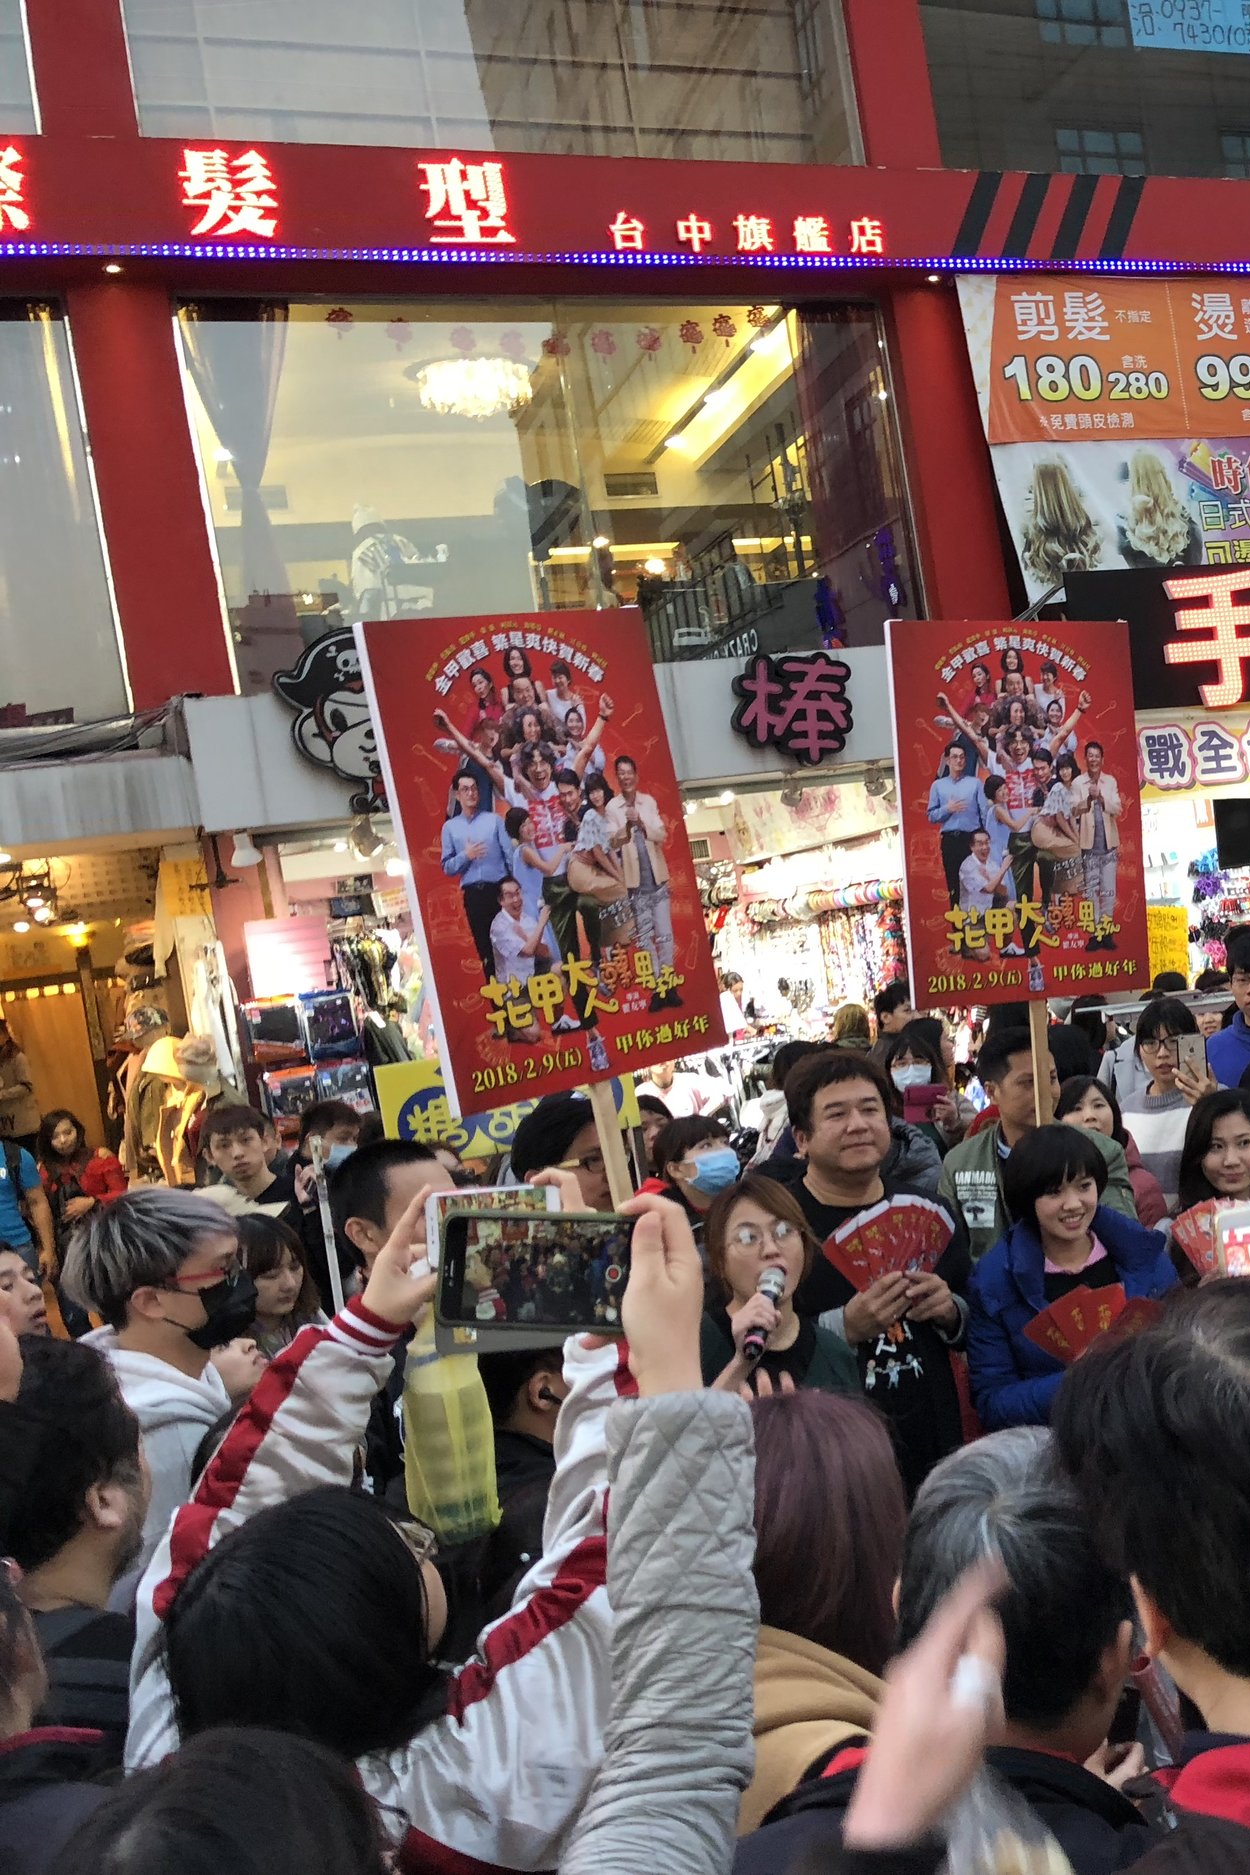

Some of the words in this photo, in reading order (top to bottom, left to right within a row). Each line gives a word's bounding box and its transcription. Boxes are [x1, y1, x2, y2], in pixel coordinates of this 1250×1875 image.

[1173, 22, 1247, 46] 743010
[607, 210, 886, 256] 台中旗艦店
[1010, 290, 1111, 341] 剪髮
[1114, 310, 1152, 324] 不指定
[1191, 291, 1239, 341] 燙
[1003, 354, 1103, 402] 180
[1107, 371, 1170, 401] 280
[740, 657, 848, 763] 棒
[927, 970, 1023, 994] 2018/2/9(五)
[471, 1048, 583, 1094] 2018/2/9(五)
